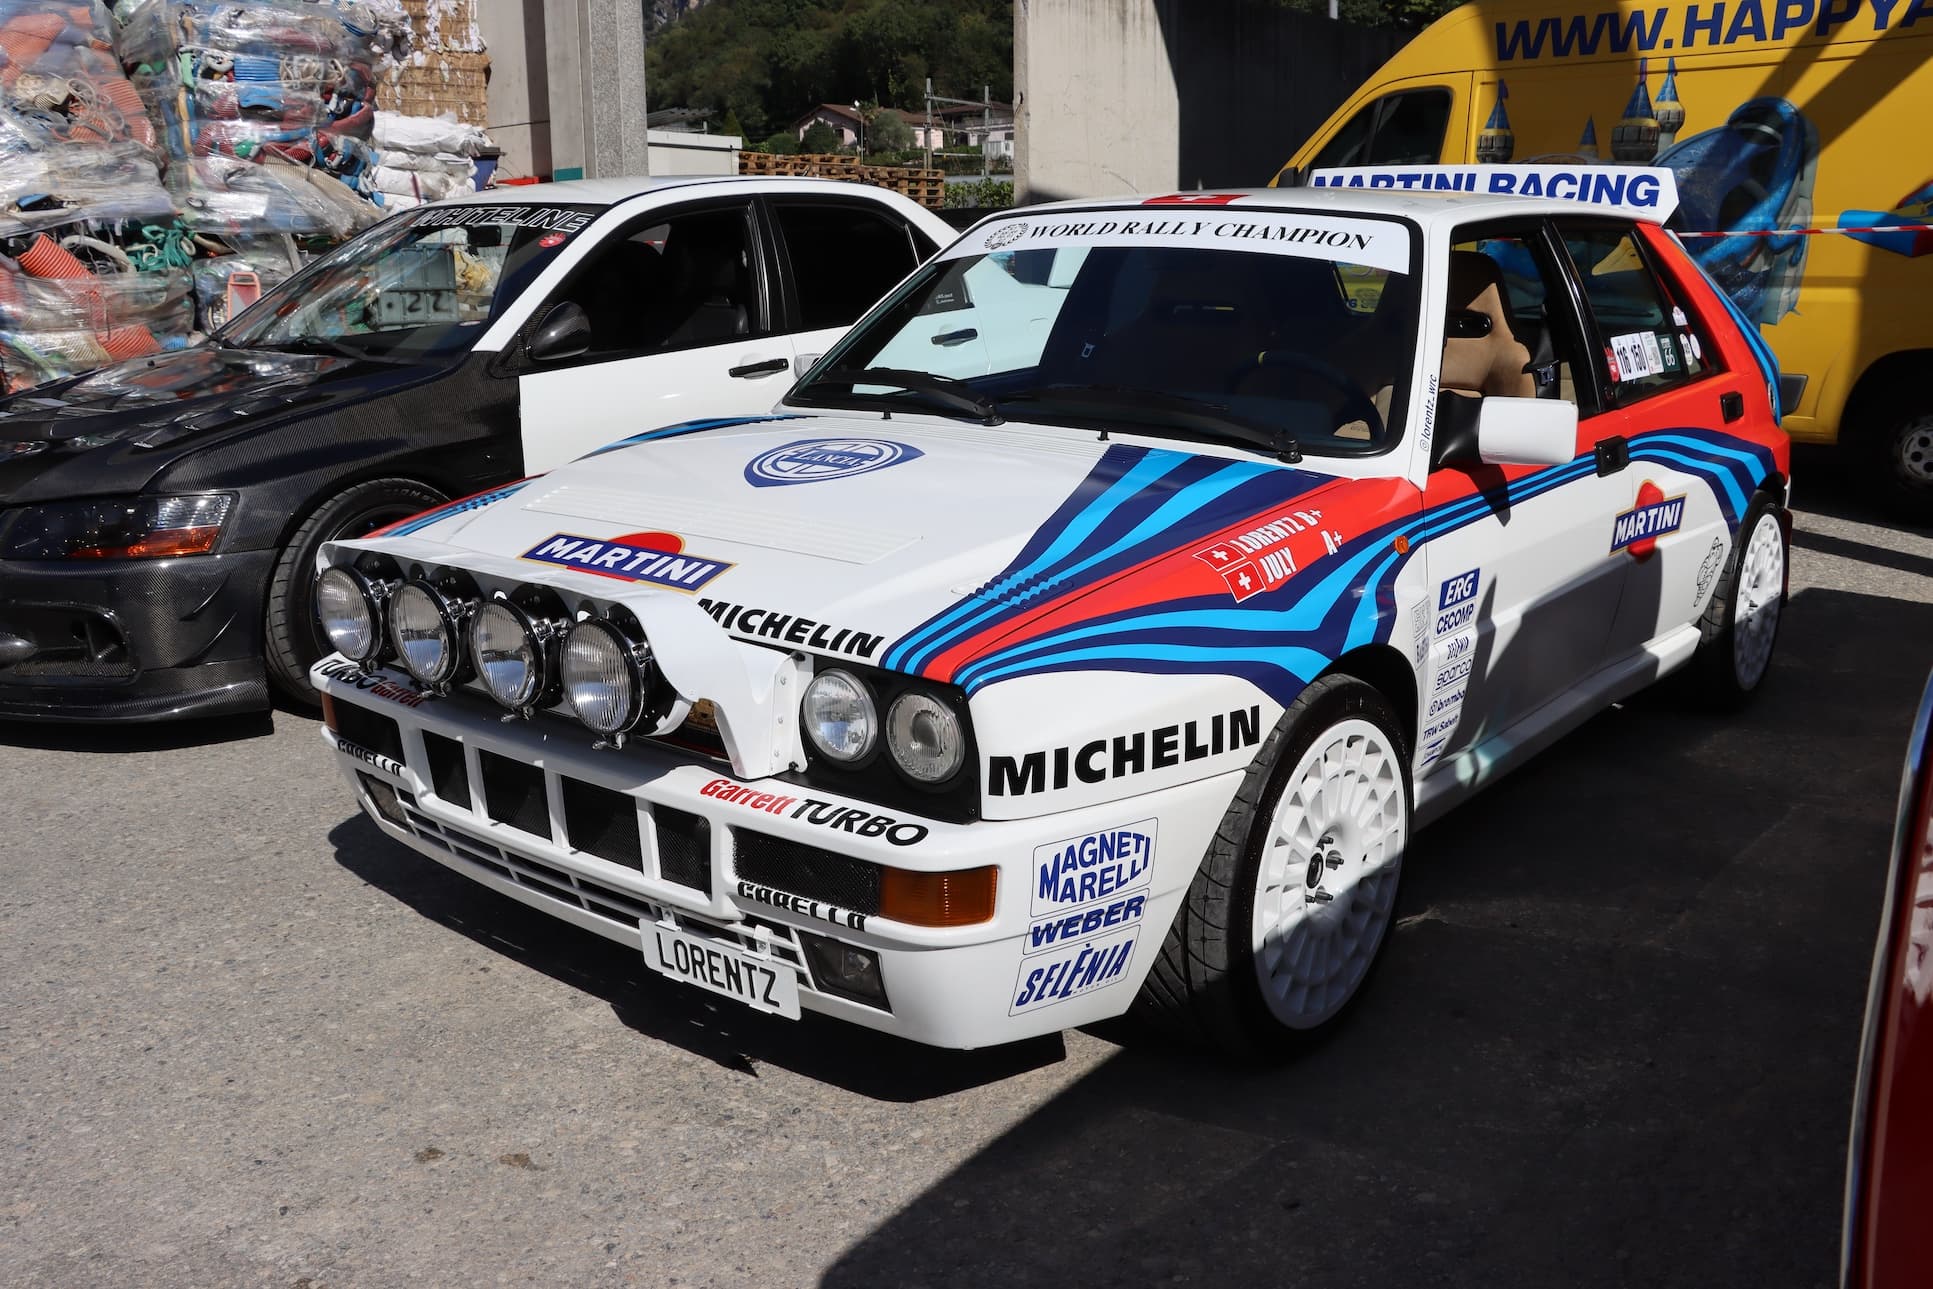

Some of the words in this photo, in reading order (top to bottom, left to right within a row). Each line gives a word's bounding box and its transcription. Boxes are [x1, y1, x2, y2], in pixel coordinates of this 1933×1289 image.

[1488, 172, 1660, 207] RACING
[410, 206, 596, 233] WHITELINE
[1030, 222, 1118, 239] WORLD
[1119, 221, 1212, 235] RALLY
[1214, 222, 1375, 251] CHAMPION
[1229, 516, 1306, 554] LORENTZ
[1293, 509, 1323, 526] B+
[1614, 502, 1682, 546] MARTINI
[536, 537, 717, 585] MARTINI
[1258, 547, 1298, 584] JULY
[1320, 530, 1343, 556] A+
[1444, 573, 1475, 606] ERG
[698, 598, 884, 658] MICHELIN
[1436, 603, 1474, 635] CECOMP
[988, 704, 1260, 797] MICHELIN
[700, 779, 798, 815] Garrett
[791, 799, 929, 846] TURBO
[1039, 831, 1151, 884] MAGNETI
[1039, 853, 1151, 903] MARELLI
[1032, 896, 1145, 947] WEBER
[656, 932, 780, 1007] LORENTZ
